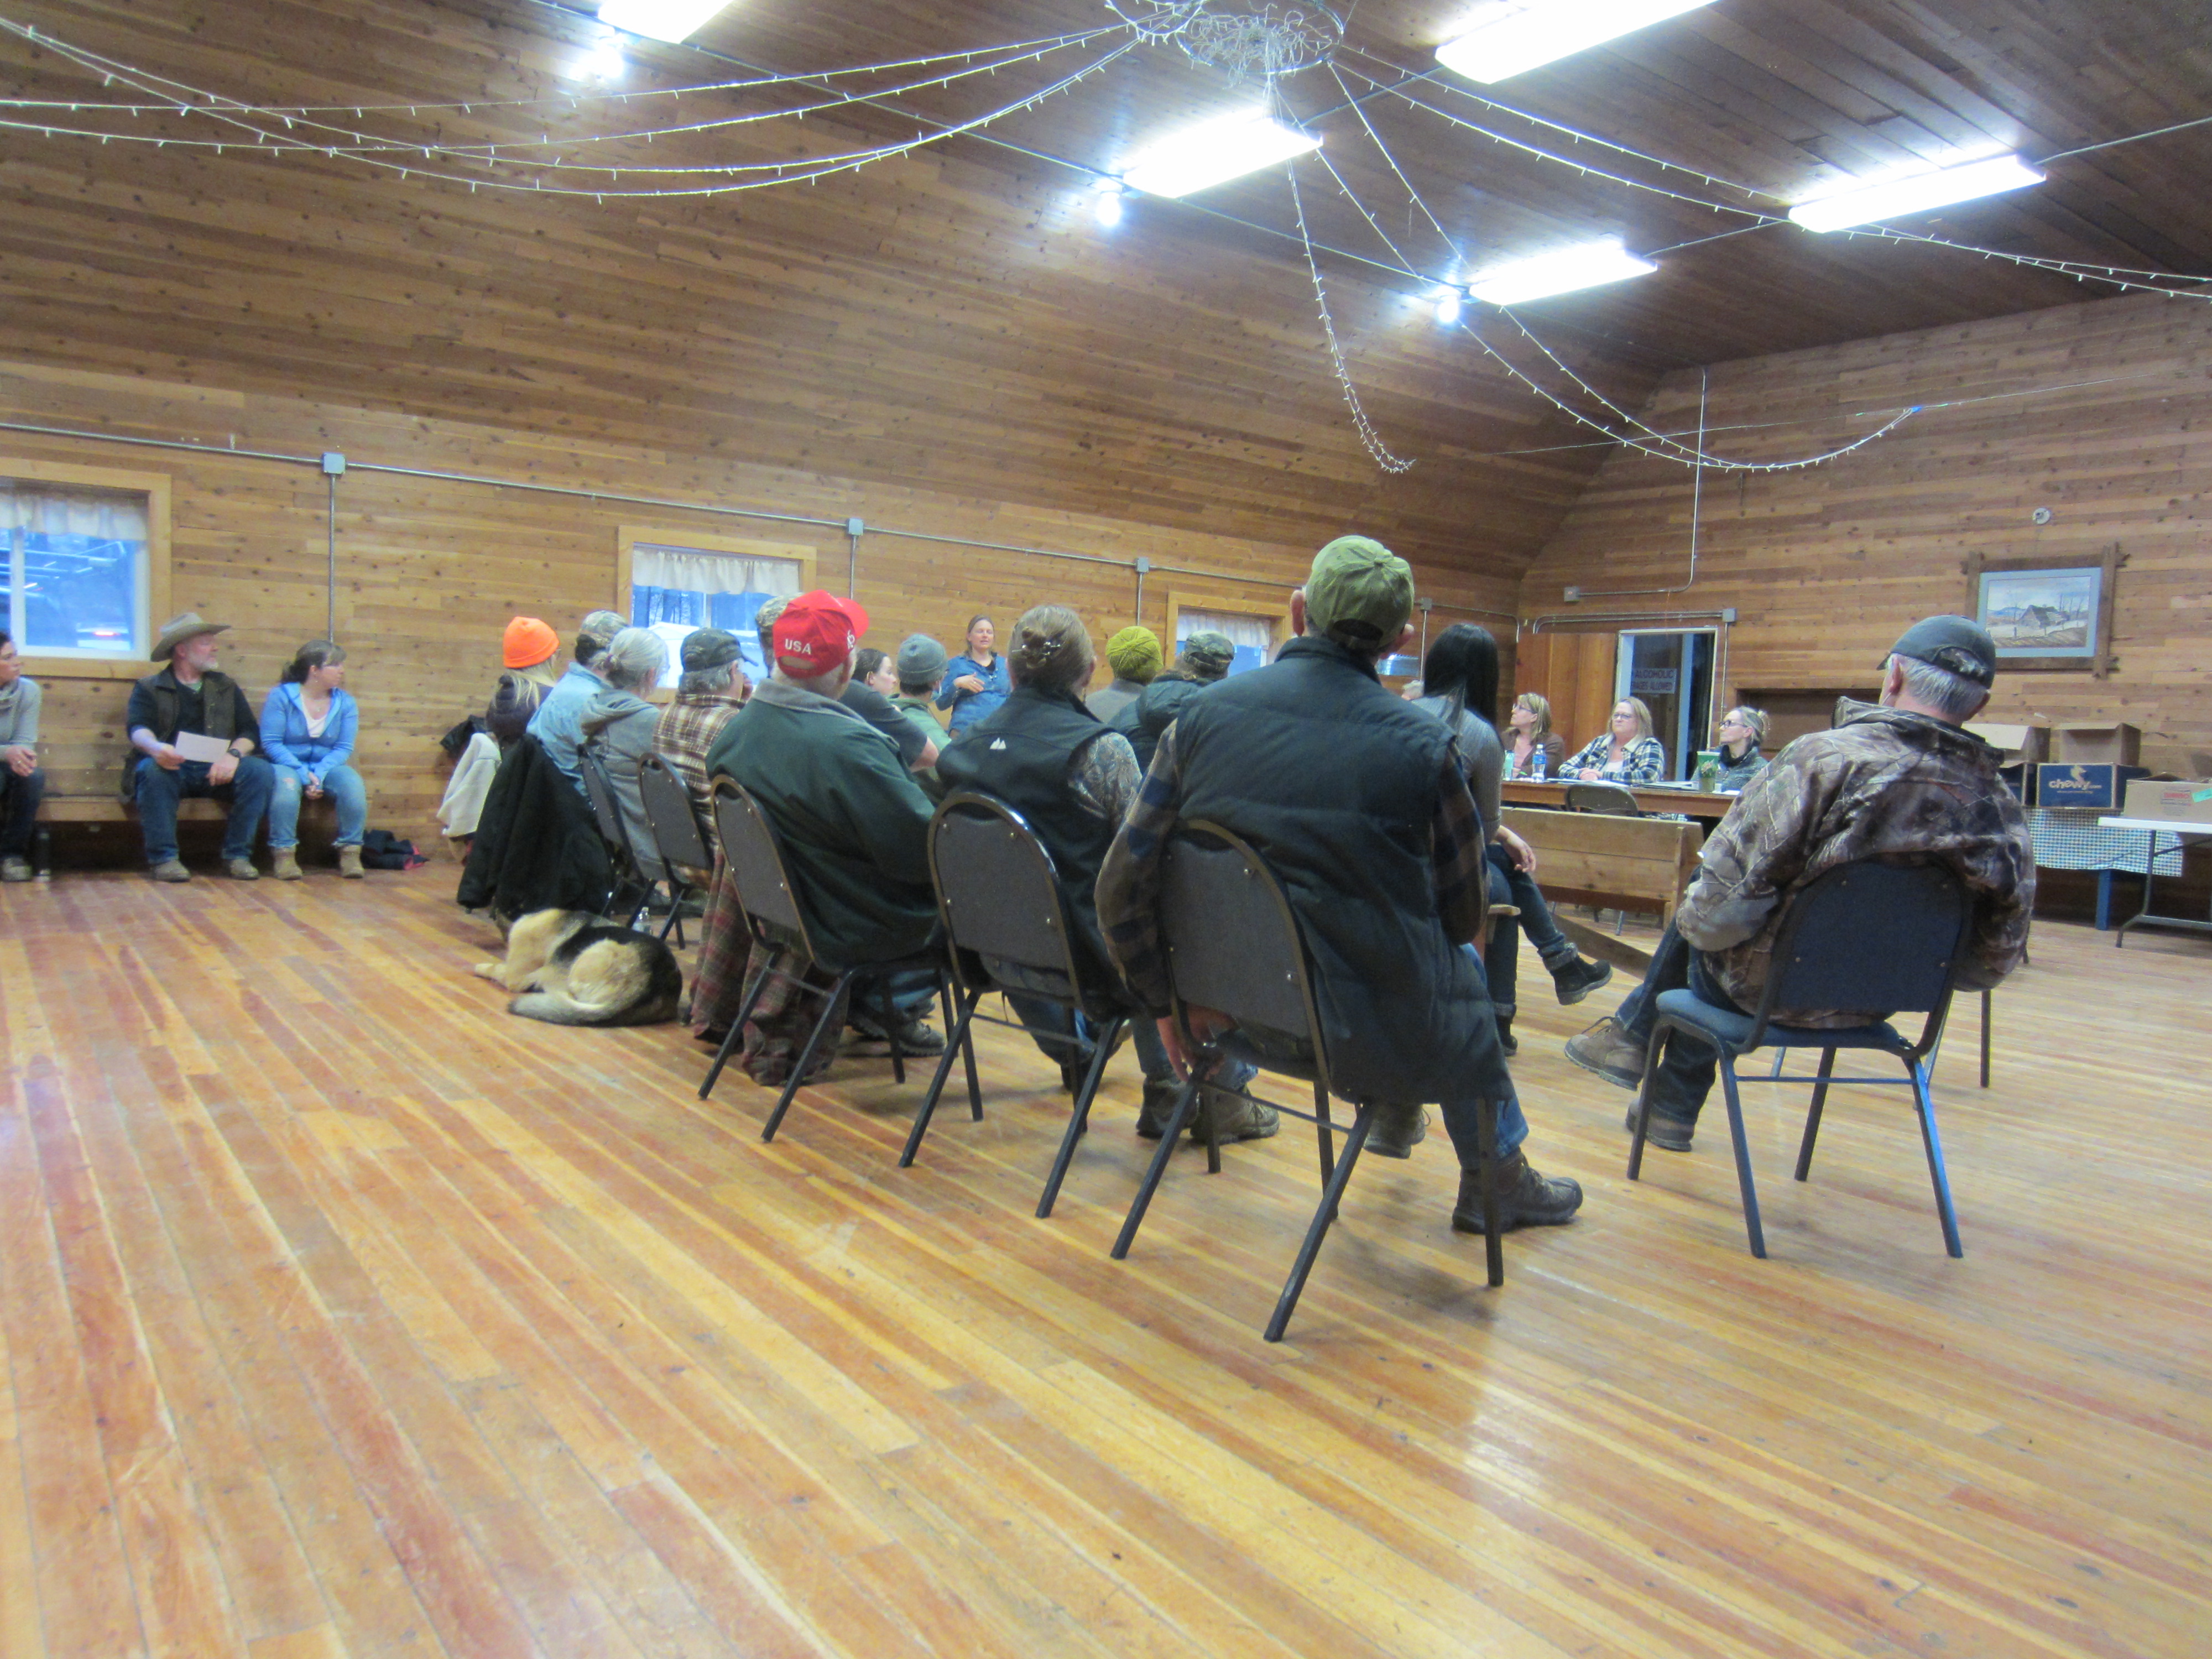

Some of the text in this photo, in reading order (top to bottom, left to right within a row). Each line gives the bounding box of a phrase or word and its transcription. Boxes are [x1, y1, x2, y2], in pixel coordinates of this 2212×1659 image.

[785, 638, 812, 655] USA
[1635, 669, 1674, 679] ALCOHOLIC
[1650, 681, 1672, 691] ALLOWED
